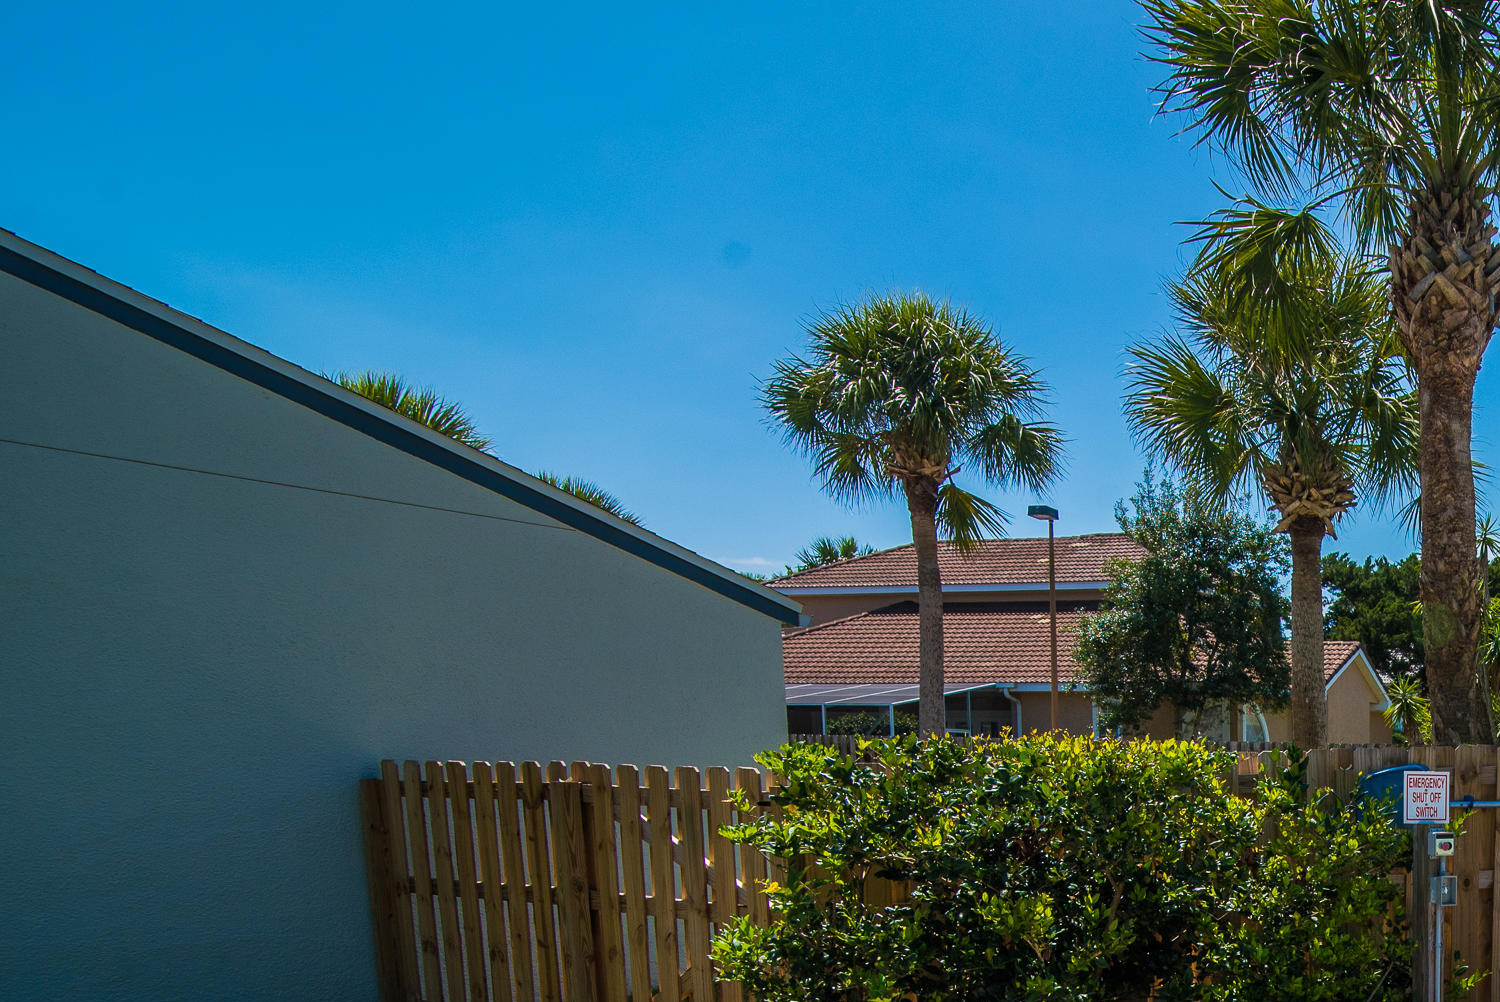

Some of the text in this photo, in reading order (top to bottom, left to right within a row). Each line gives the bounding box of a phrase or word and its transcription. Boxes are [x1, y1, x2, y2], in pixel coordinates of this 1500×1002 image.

[1409, 777, 1445, 789] EMERGENCY
[1413, 792, 1441, 803] SHUT OFF
[1416, 806, 1438, 817] SWITCH
